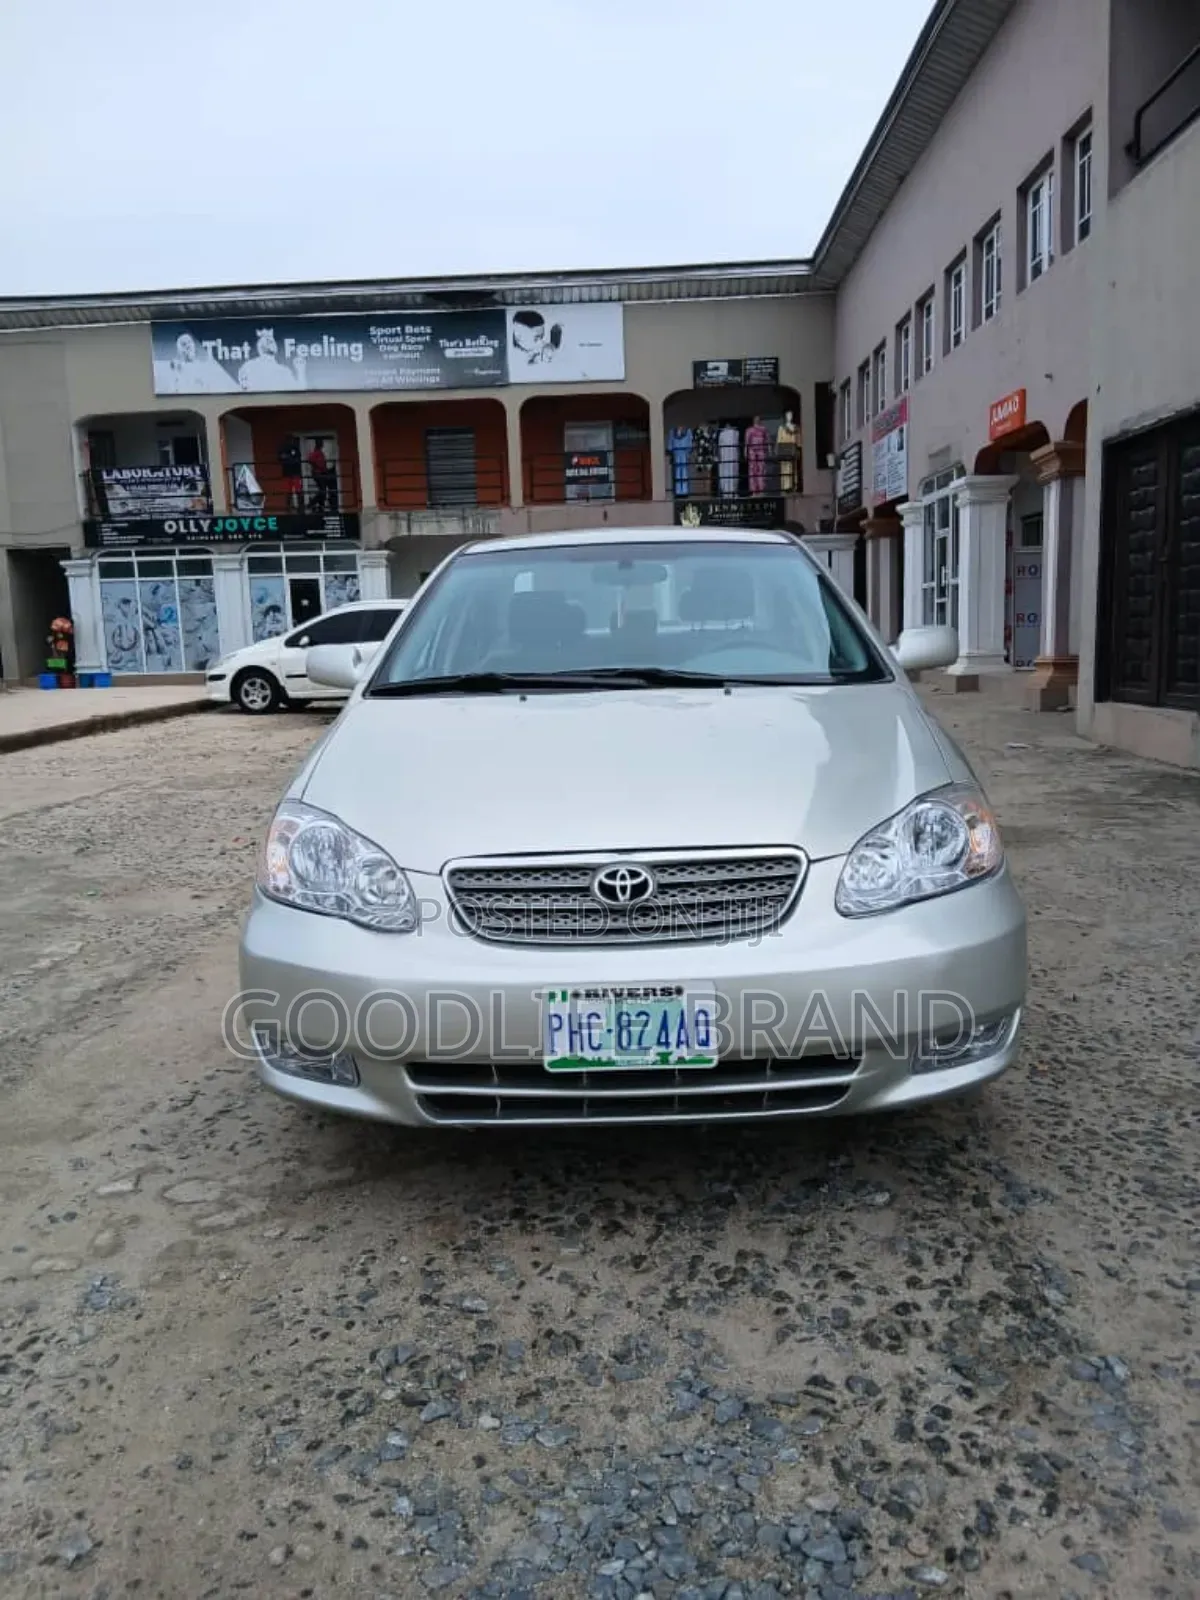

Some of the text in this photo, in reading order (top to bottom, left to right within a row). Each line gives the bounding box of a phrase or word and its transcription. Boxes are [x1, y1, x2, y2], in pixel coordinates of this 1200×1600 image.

[369, 325, 402, 336] Sport
[201, 335, 363, 363] That Feeling
[585, 986, 674, 999] RIVERS
